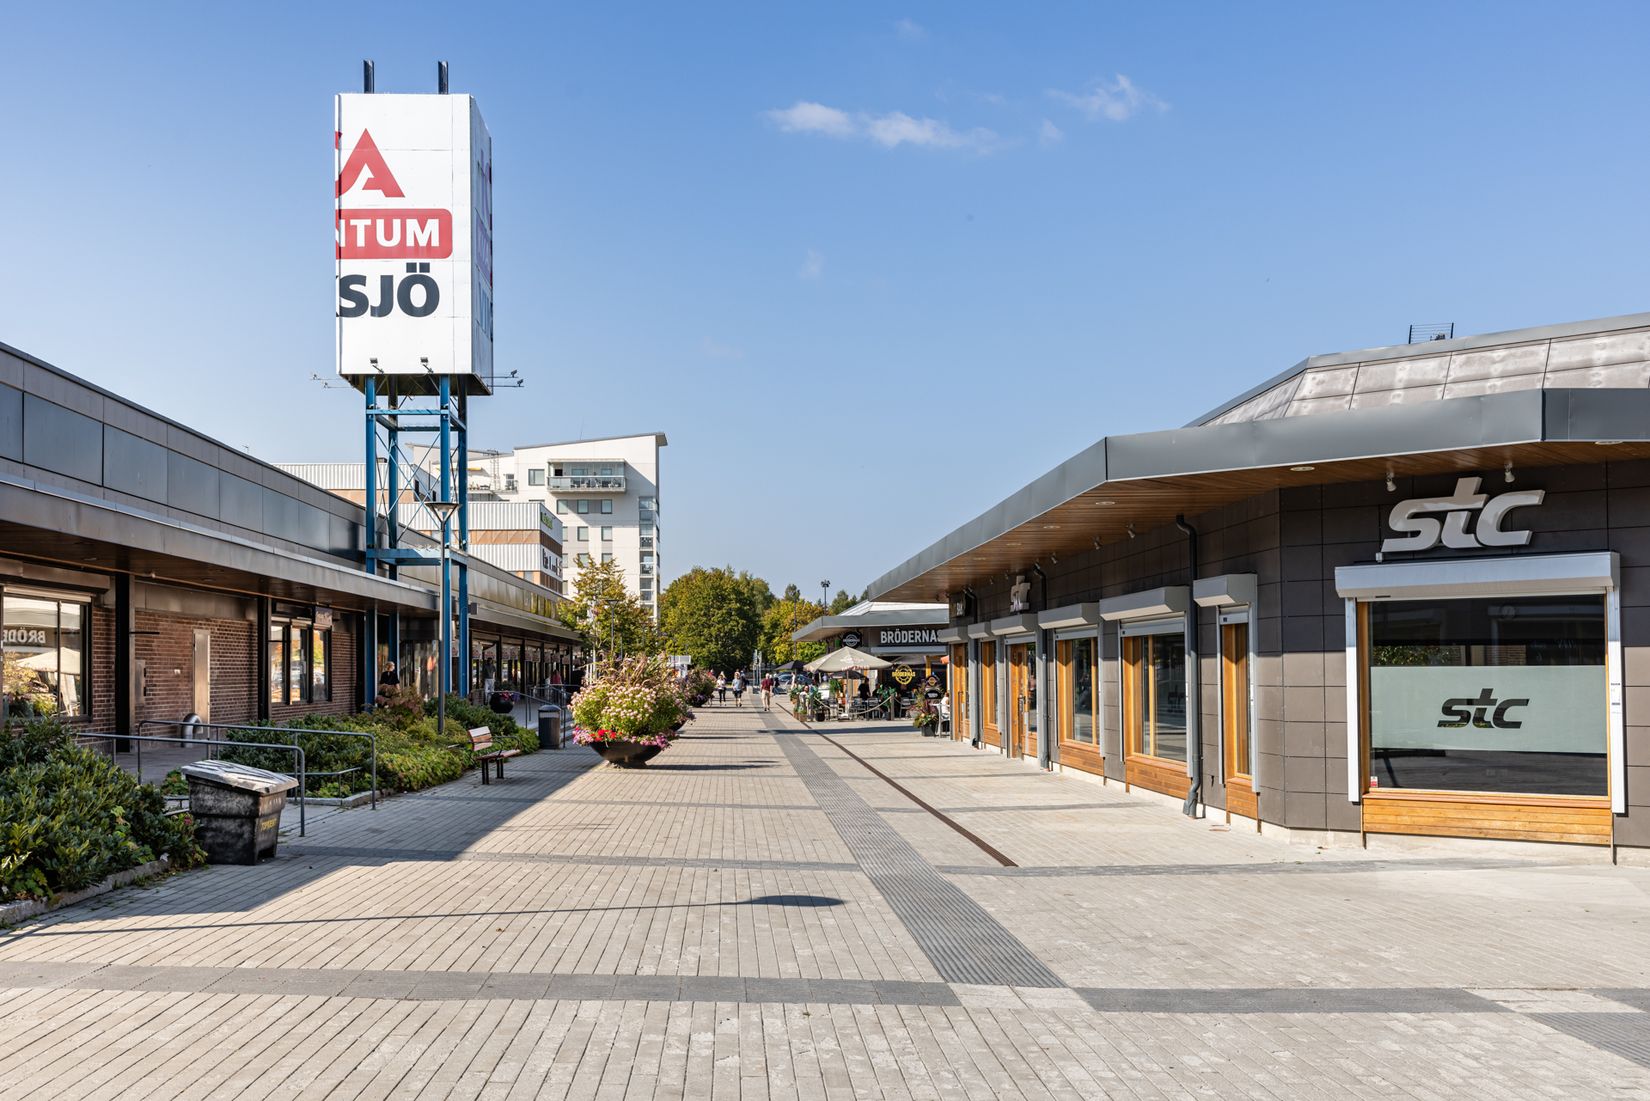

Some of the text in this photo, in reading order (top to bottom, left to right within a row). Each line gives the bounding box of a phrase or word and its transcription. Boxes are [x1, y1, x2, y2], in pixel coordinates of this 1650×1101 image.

[335, 128, 405, 198] A
[336, 262, 440, 318] SJÖ
[1381, 477, 1546, 553] stc
[1437, 688, 1529, 729] stc
